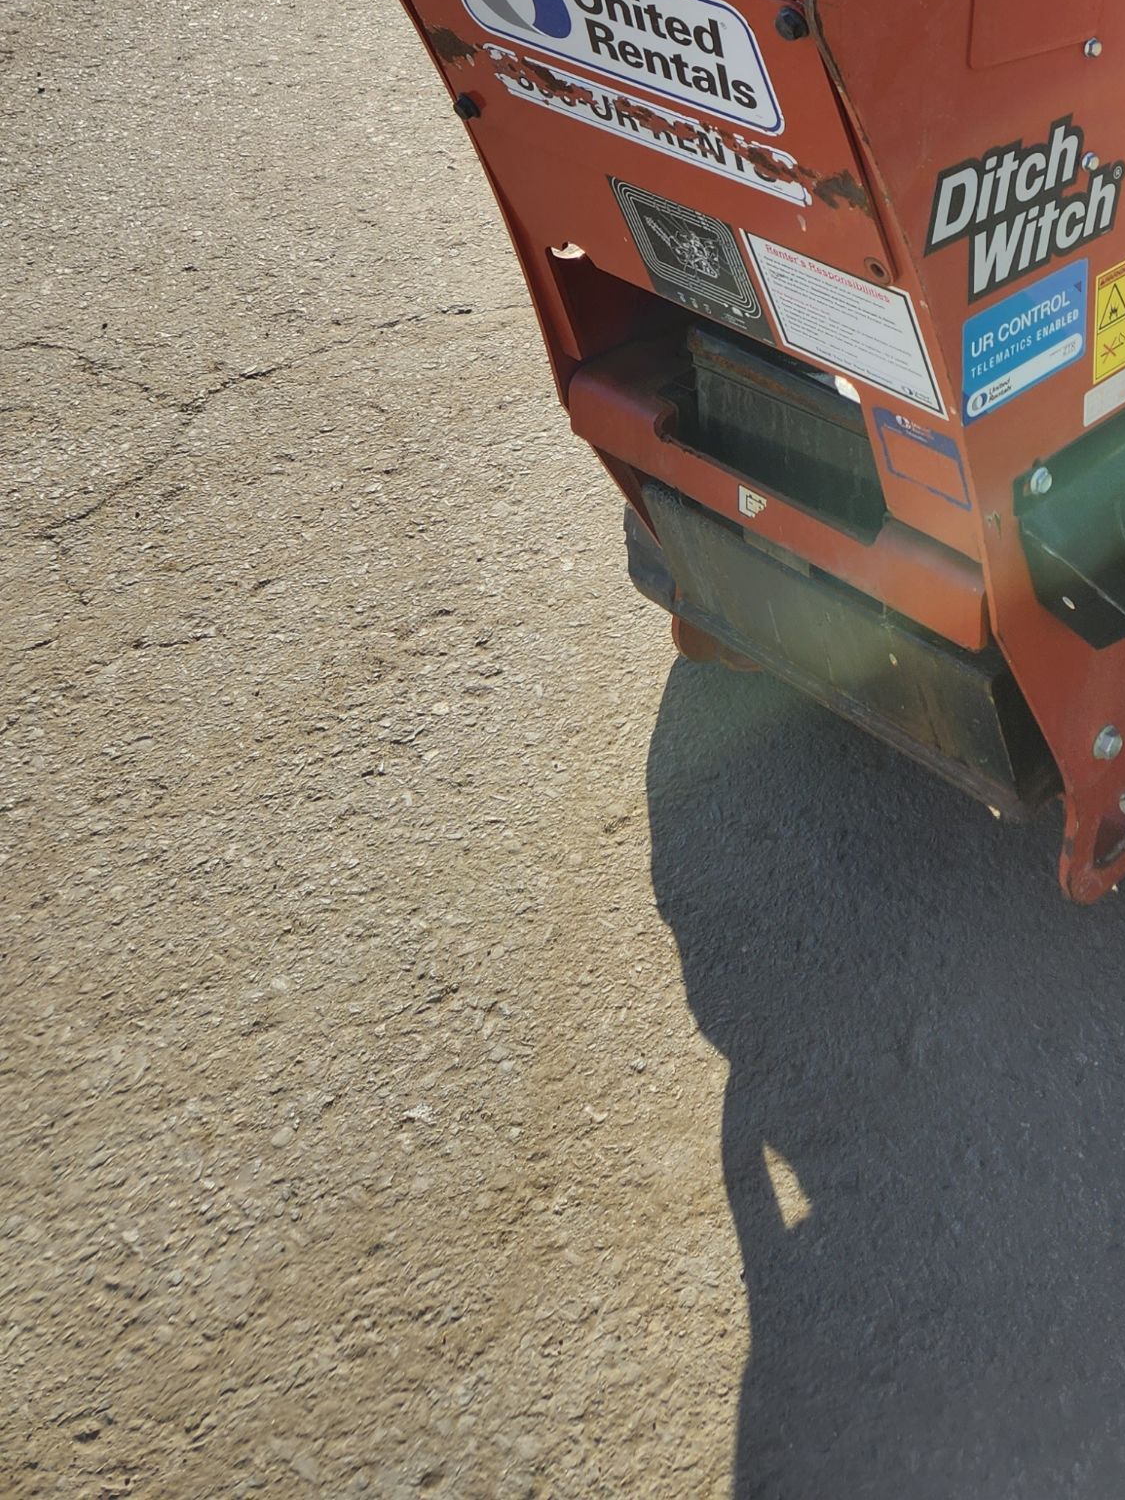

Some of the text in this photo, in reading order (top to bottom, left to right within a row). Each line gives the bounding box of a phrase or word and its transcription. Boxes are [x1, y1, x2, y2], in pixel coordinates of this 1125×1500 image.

[585, 18, 758, 109] Rentals
[932, 126, 1079, 245] Ditch
[973, 172, 1117, 294] Witch
[765, 244, 890, 303] Renter's Responsibilities
[971, 292, 1071, 358] UR CONTROL
[971, 336, 1032, 378] TELEMATICS
[1036, 309, 1079, 342] ENABLED
